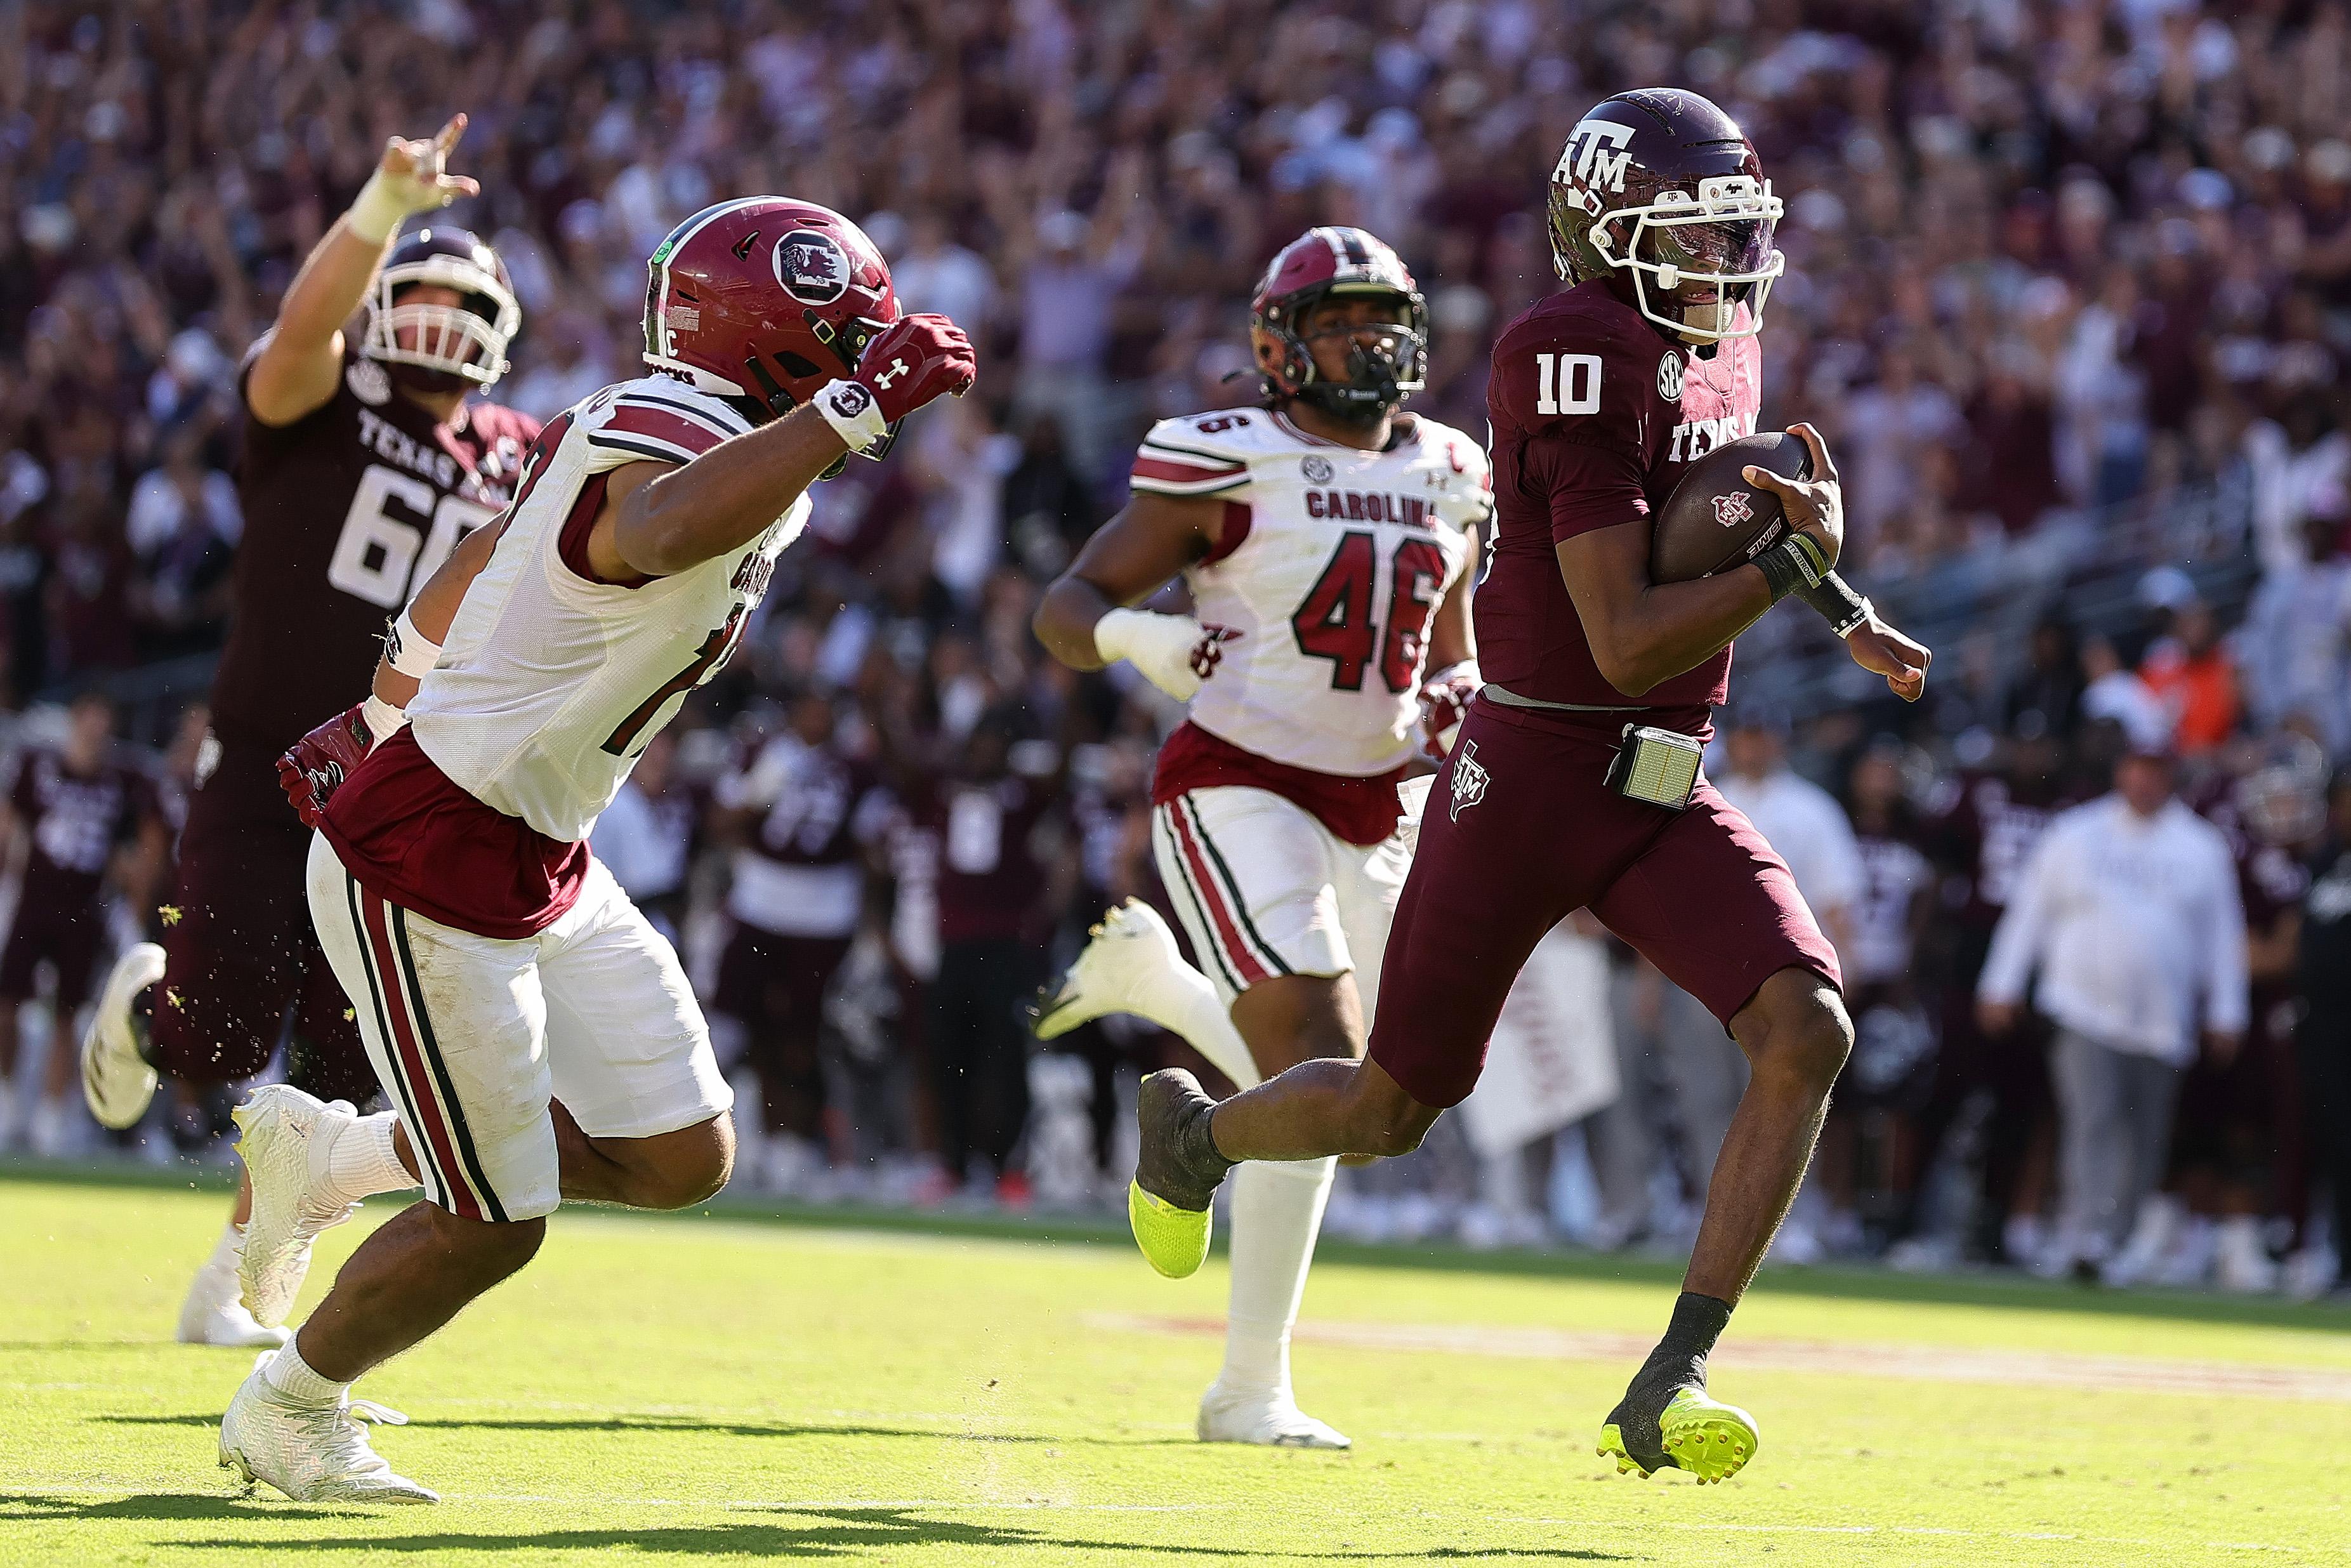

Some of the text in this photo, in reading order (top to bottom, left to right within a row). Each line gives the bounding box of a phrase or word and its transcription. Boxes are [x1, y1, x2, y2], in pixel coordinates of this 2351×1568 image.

[667, 329, 678, 357] C
[1536, 353, 1602, 414] 10
[1660, 354, 1683, 398] SEC
[1306, 492, 1435, 529] CAROLIN
[1746, 517, 1782, 560] DIME
[1796, 555, 1816, 583] STRONG
[1291, 530, 1446, 694] 46
